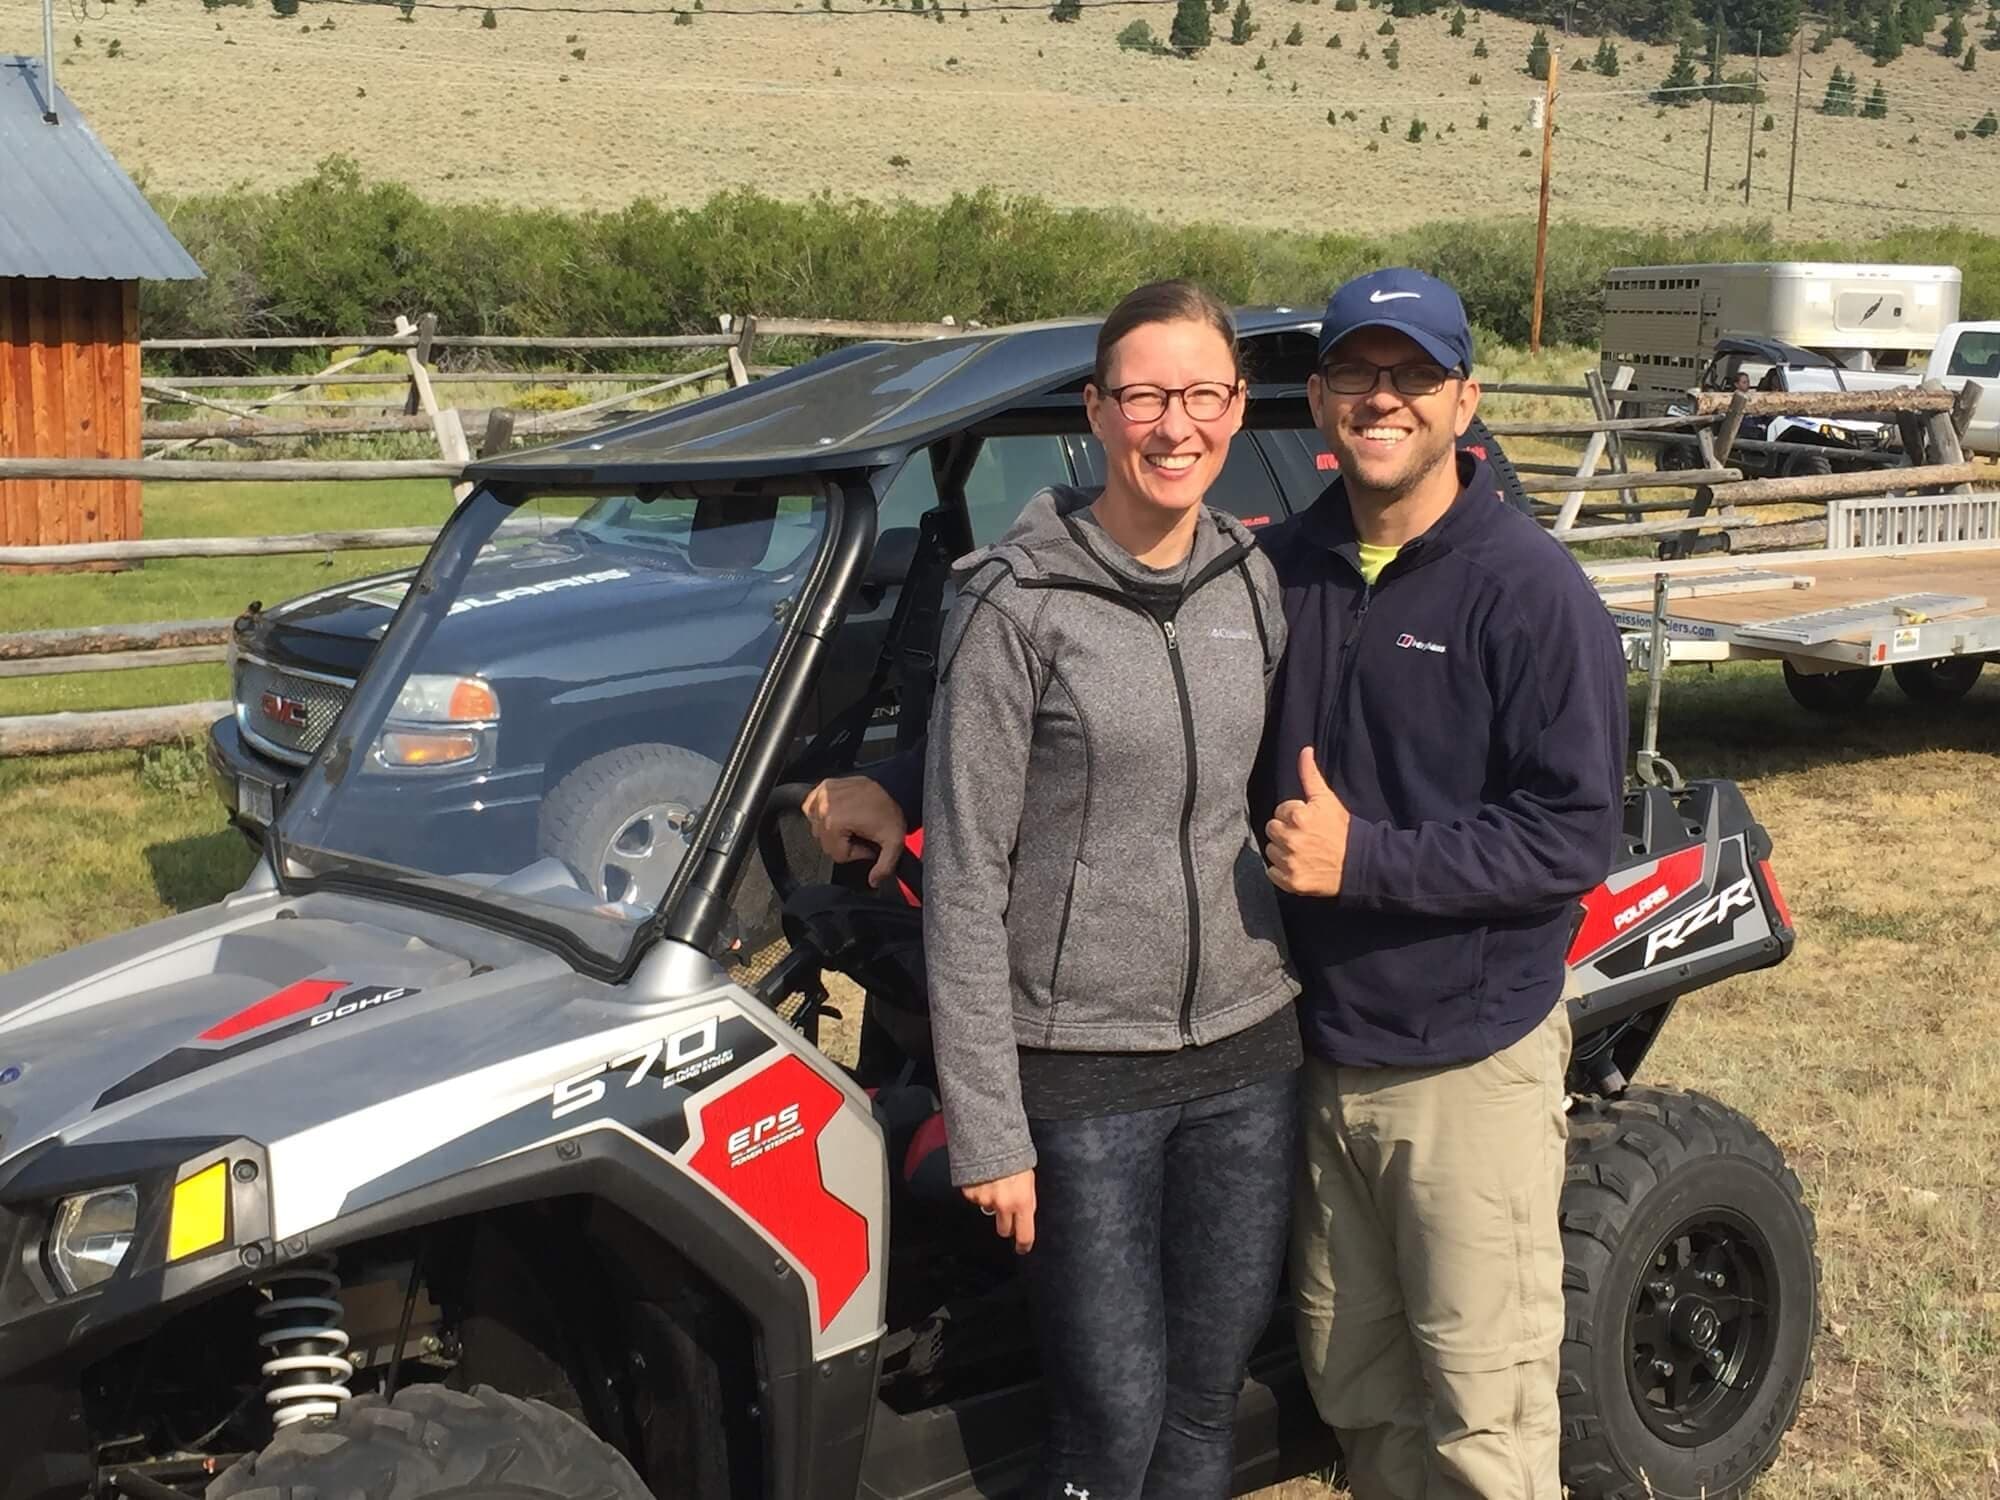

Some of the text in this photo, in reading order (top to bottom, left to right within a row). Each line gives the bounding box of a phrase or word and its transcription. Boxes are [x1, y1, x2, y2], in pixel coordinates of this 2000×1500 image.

[446, 569, 631, 616] LARIS
[1614, 613, 1715, 637] missionlers.com
[260, 691, 306, 727] GMC
[1613, 884, 1670, 930] POLARIS
[1643, 877, 1753, 968] RZR
[310, 987, 405, 1027] DOHC
[552, 1015, 719, 1119] 570
[727, 1103, 800, 1155] EPS
